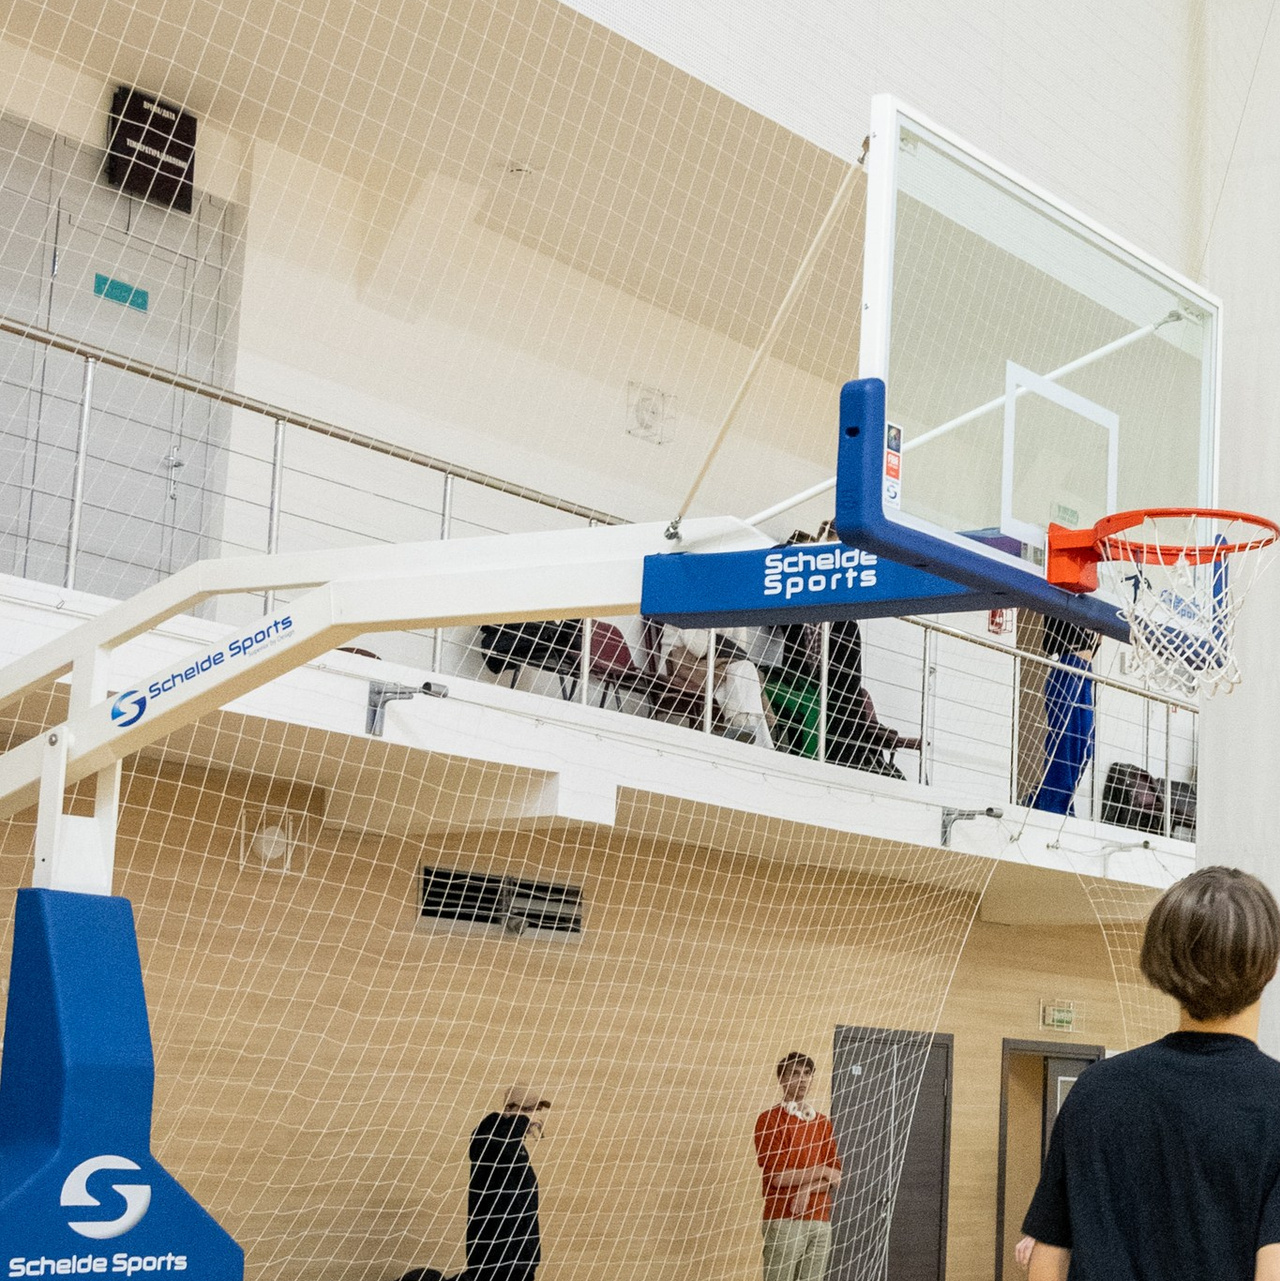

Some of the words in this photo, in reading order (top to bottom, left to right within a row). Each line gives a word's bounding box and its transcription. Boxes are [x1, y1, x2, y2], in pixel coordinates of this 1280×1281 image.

[764, 548, 878, 575] Schelde
[763, 567, 877, 600] Sports
[148, 651, 225, 700] Schelde
[228, 615, 293, 656] Sports
[8, 1254, 108, 1278] Schelde
[112, 1251, 188, 1277] Sports
